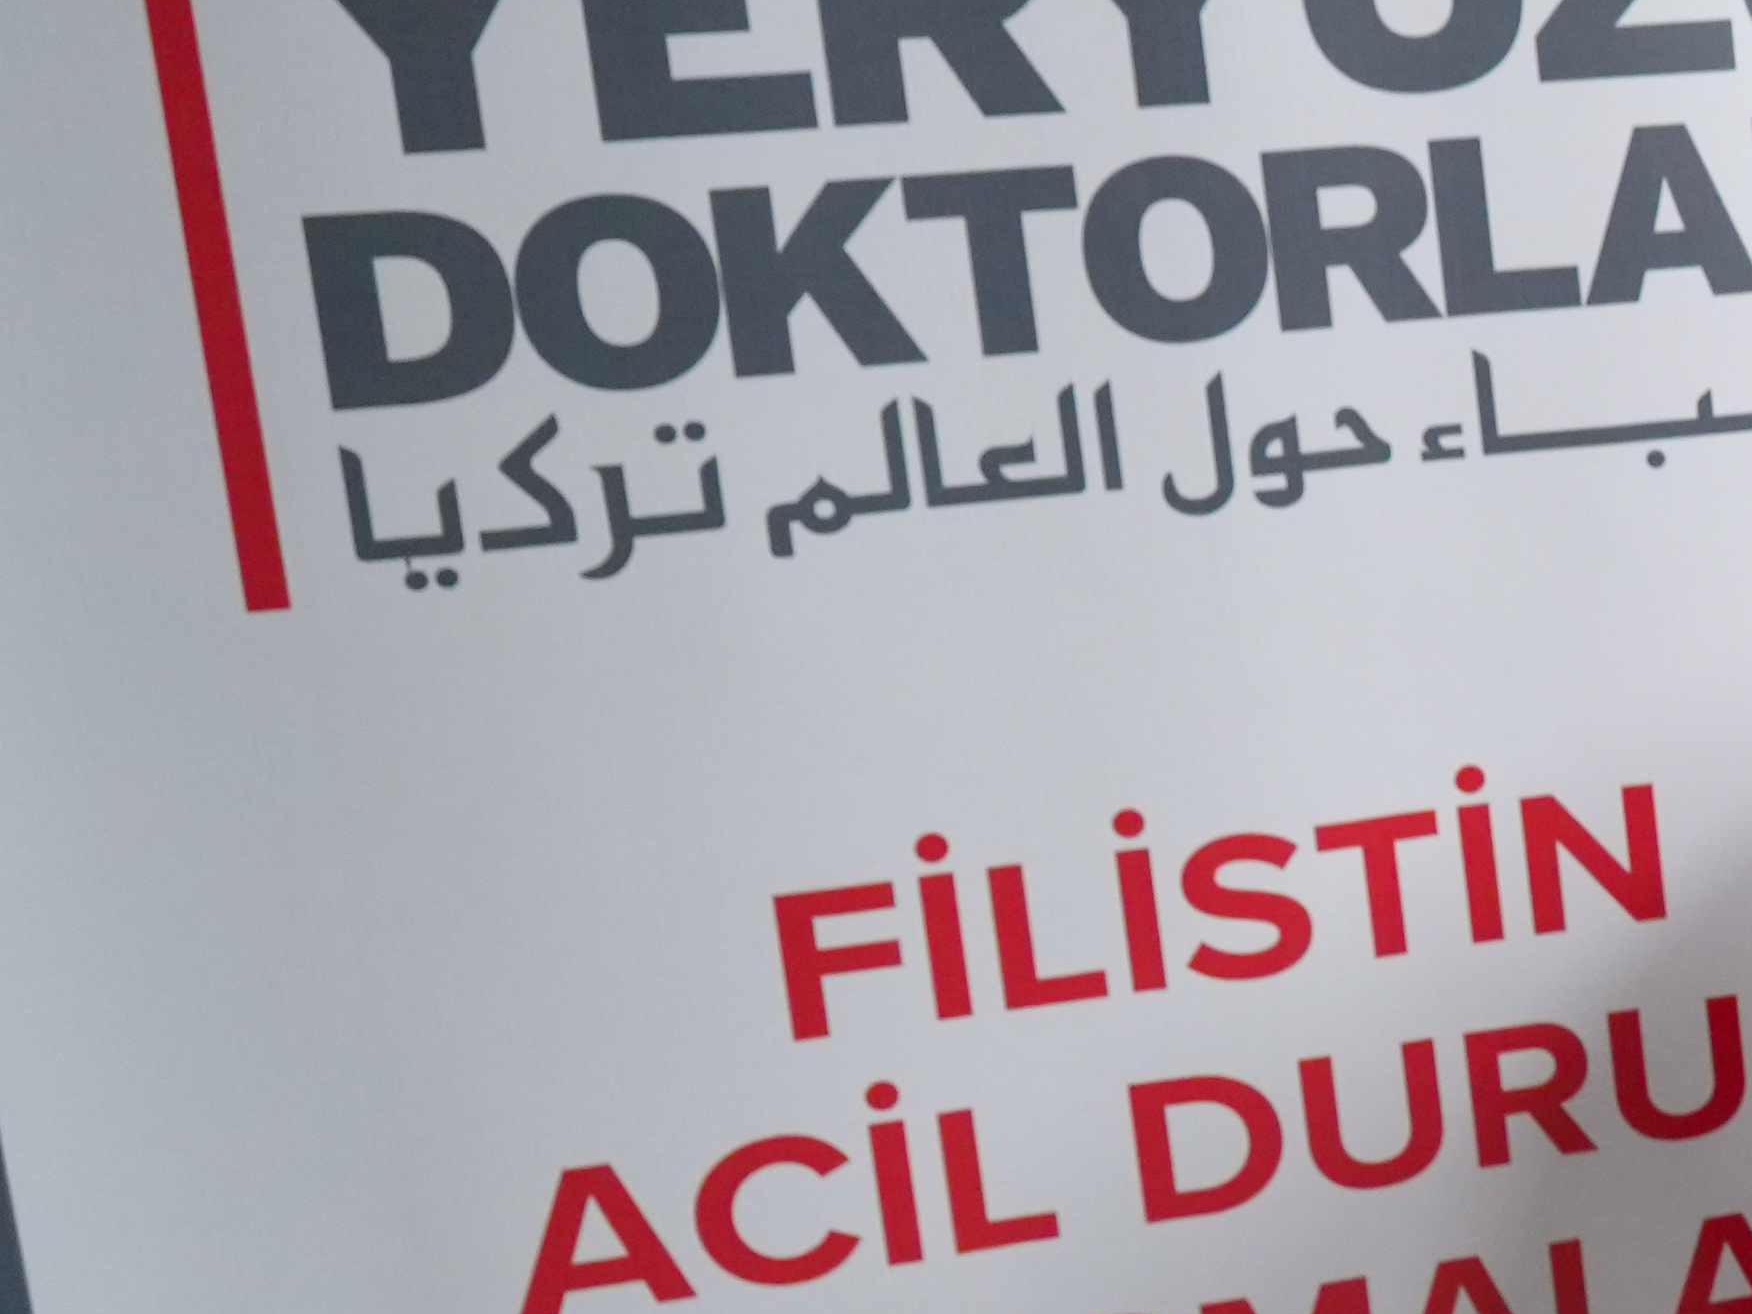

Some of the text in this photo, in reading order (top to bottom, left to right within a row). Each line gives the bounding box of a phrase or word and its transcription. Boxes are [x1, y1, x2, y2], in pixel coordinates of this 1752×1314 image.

[338, 416, 725, 592] تركيا
[766, 385, 1122, 559] العالم
[1163, 376, 1390, 517] حول
[770, 764, 1671, 1041] FİLİSTİN
